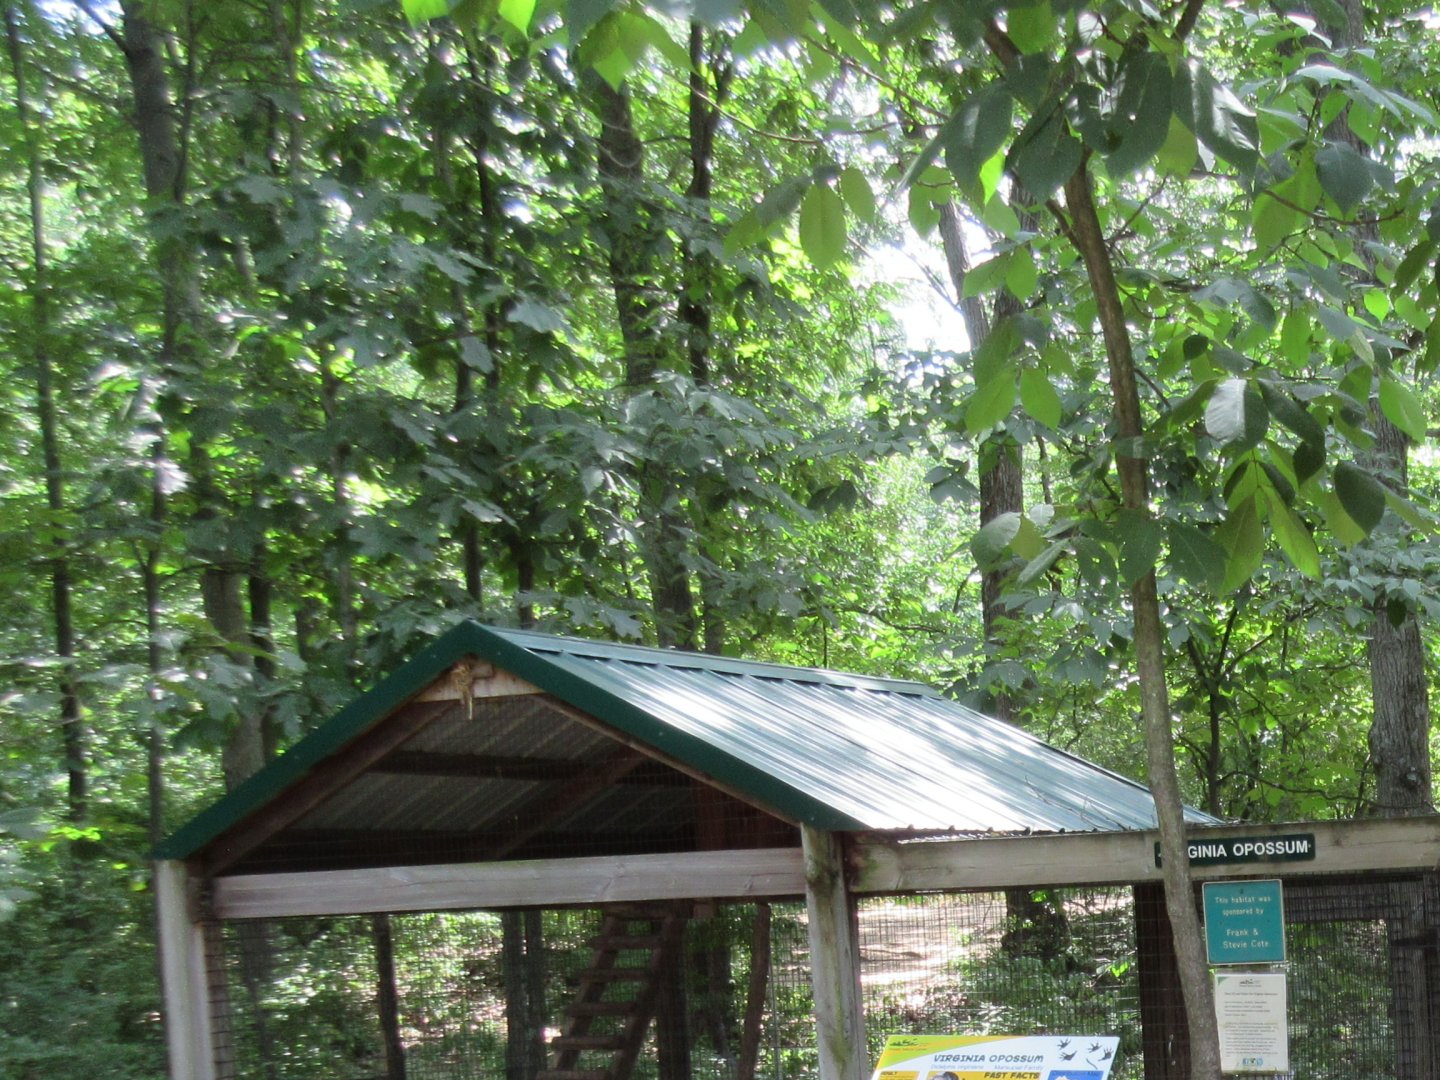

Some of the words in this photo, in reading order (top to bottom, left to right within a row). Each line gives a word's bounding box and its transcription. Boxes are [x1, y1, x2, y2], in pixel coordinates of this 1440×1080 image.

[1188, 844, 1227, 859] GINIA
[1233, 840, 1309, 857] OPOSSUM
[1215, 896, 1228, 904] This
[1231, 896, 1255, 904] habitat
[1223, 908, 1253, 916] sponsored
[1226, 929, 1248, 937] Frank
[1253, 928, 1259, 936] &
[1223, 940, 1247, 949] Stevie
[934, 1054, 985, 1063] VIRGINIA
[989, 1054, 1044, 1063] OPOSSUM
